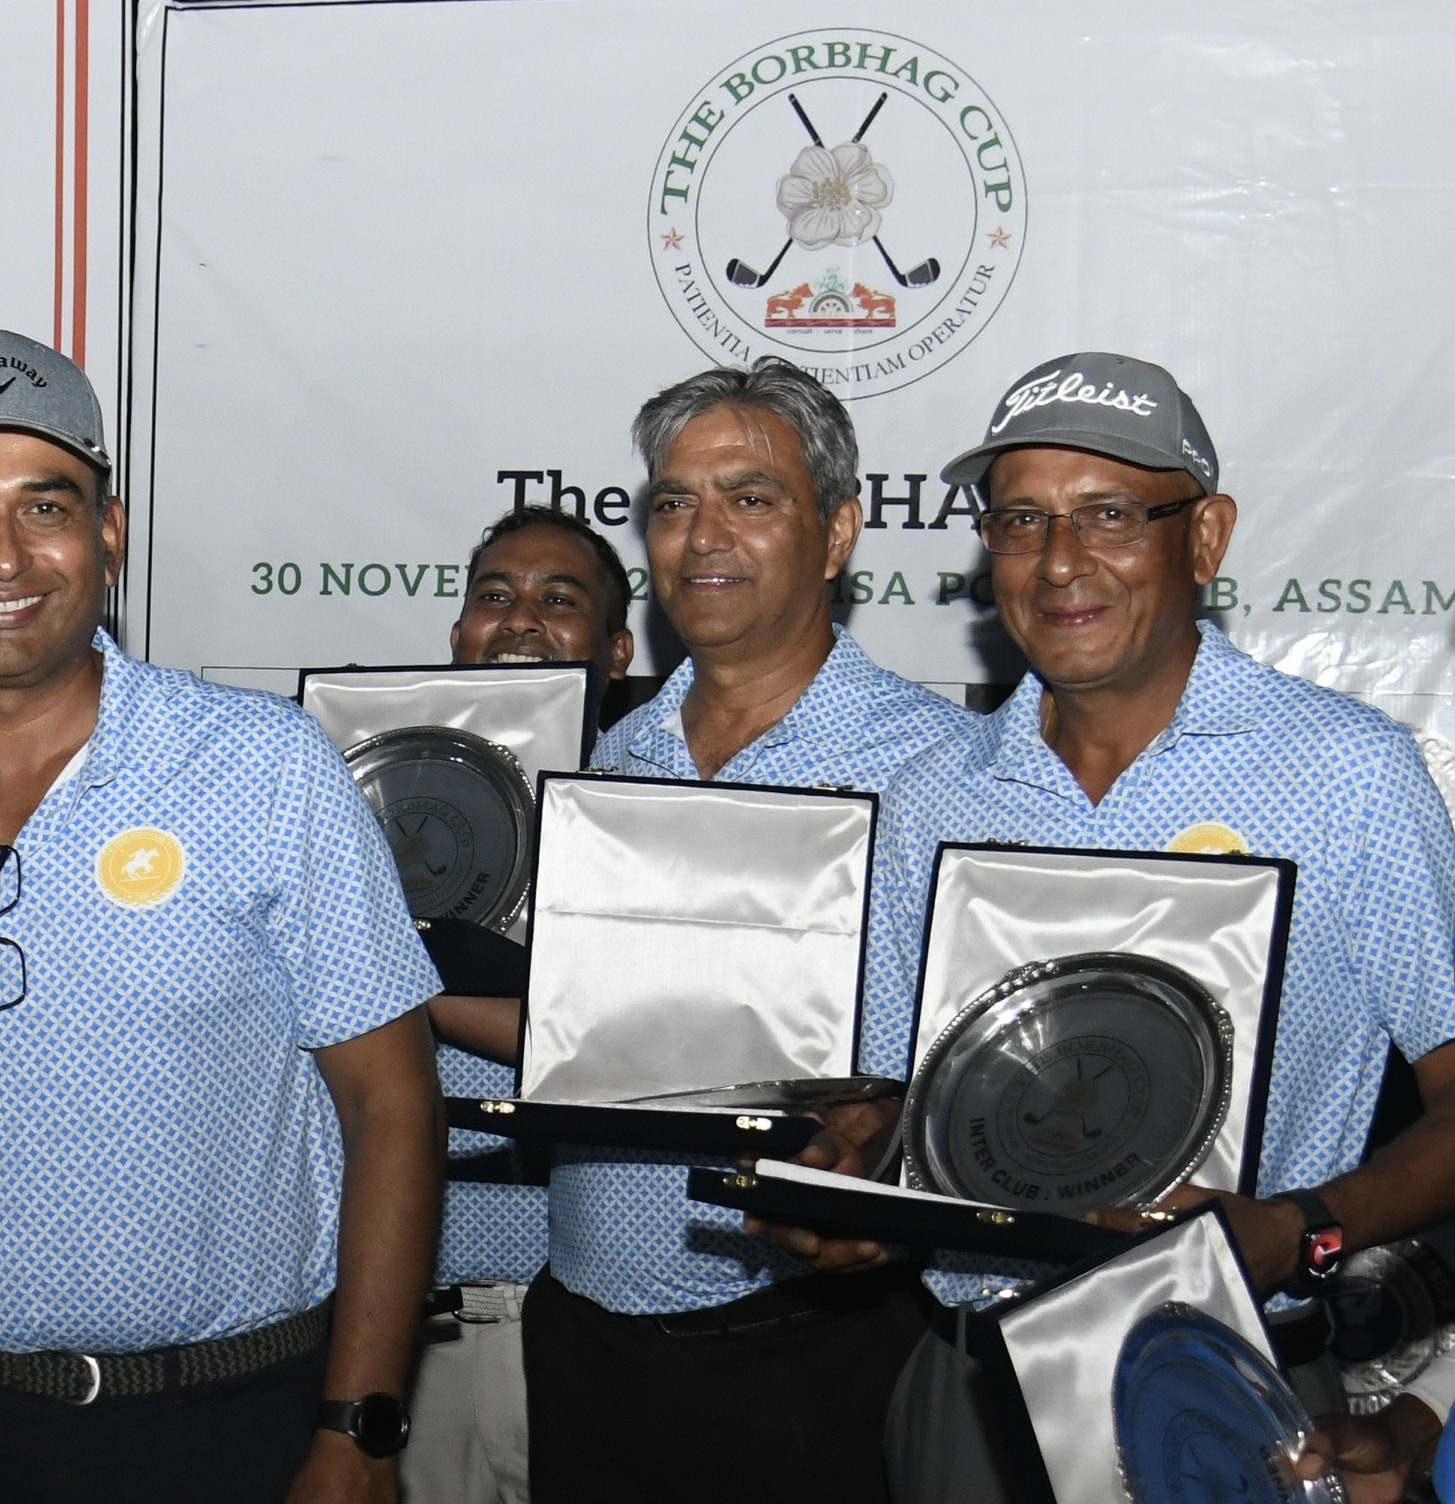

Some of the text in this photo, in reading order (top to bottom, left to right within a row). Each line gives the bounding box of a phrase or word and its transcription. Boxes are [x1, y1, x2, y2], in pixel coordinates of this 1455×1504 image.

[660, 41, 1015, 216] THE BORBHAG CUP
[675, 261, 751, 362] PATIENTIA
[908, 263, 996, 362] OPERATUR
[991, 369, 1158, 435] Titleist
[496, 470, 631, 527] The
[250, 561, 302, 596] 30
[319, 562, 469, 598] NOVE
[444, 871, 491, 919] INNER
[969, 1116, 997, 1175] INTER
[991, 1168, 1041, 1201] CLUB
[1057, 1151, 1143, 1200] WINNER
